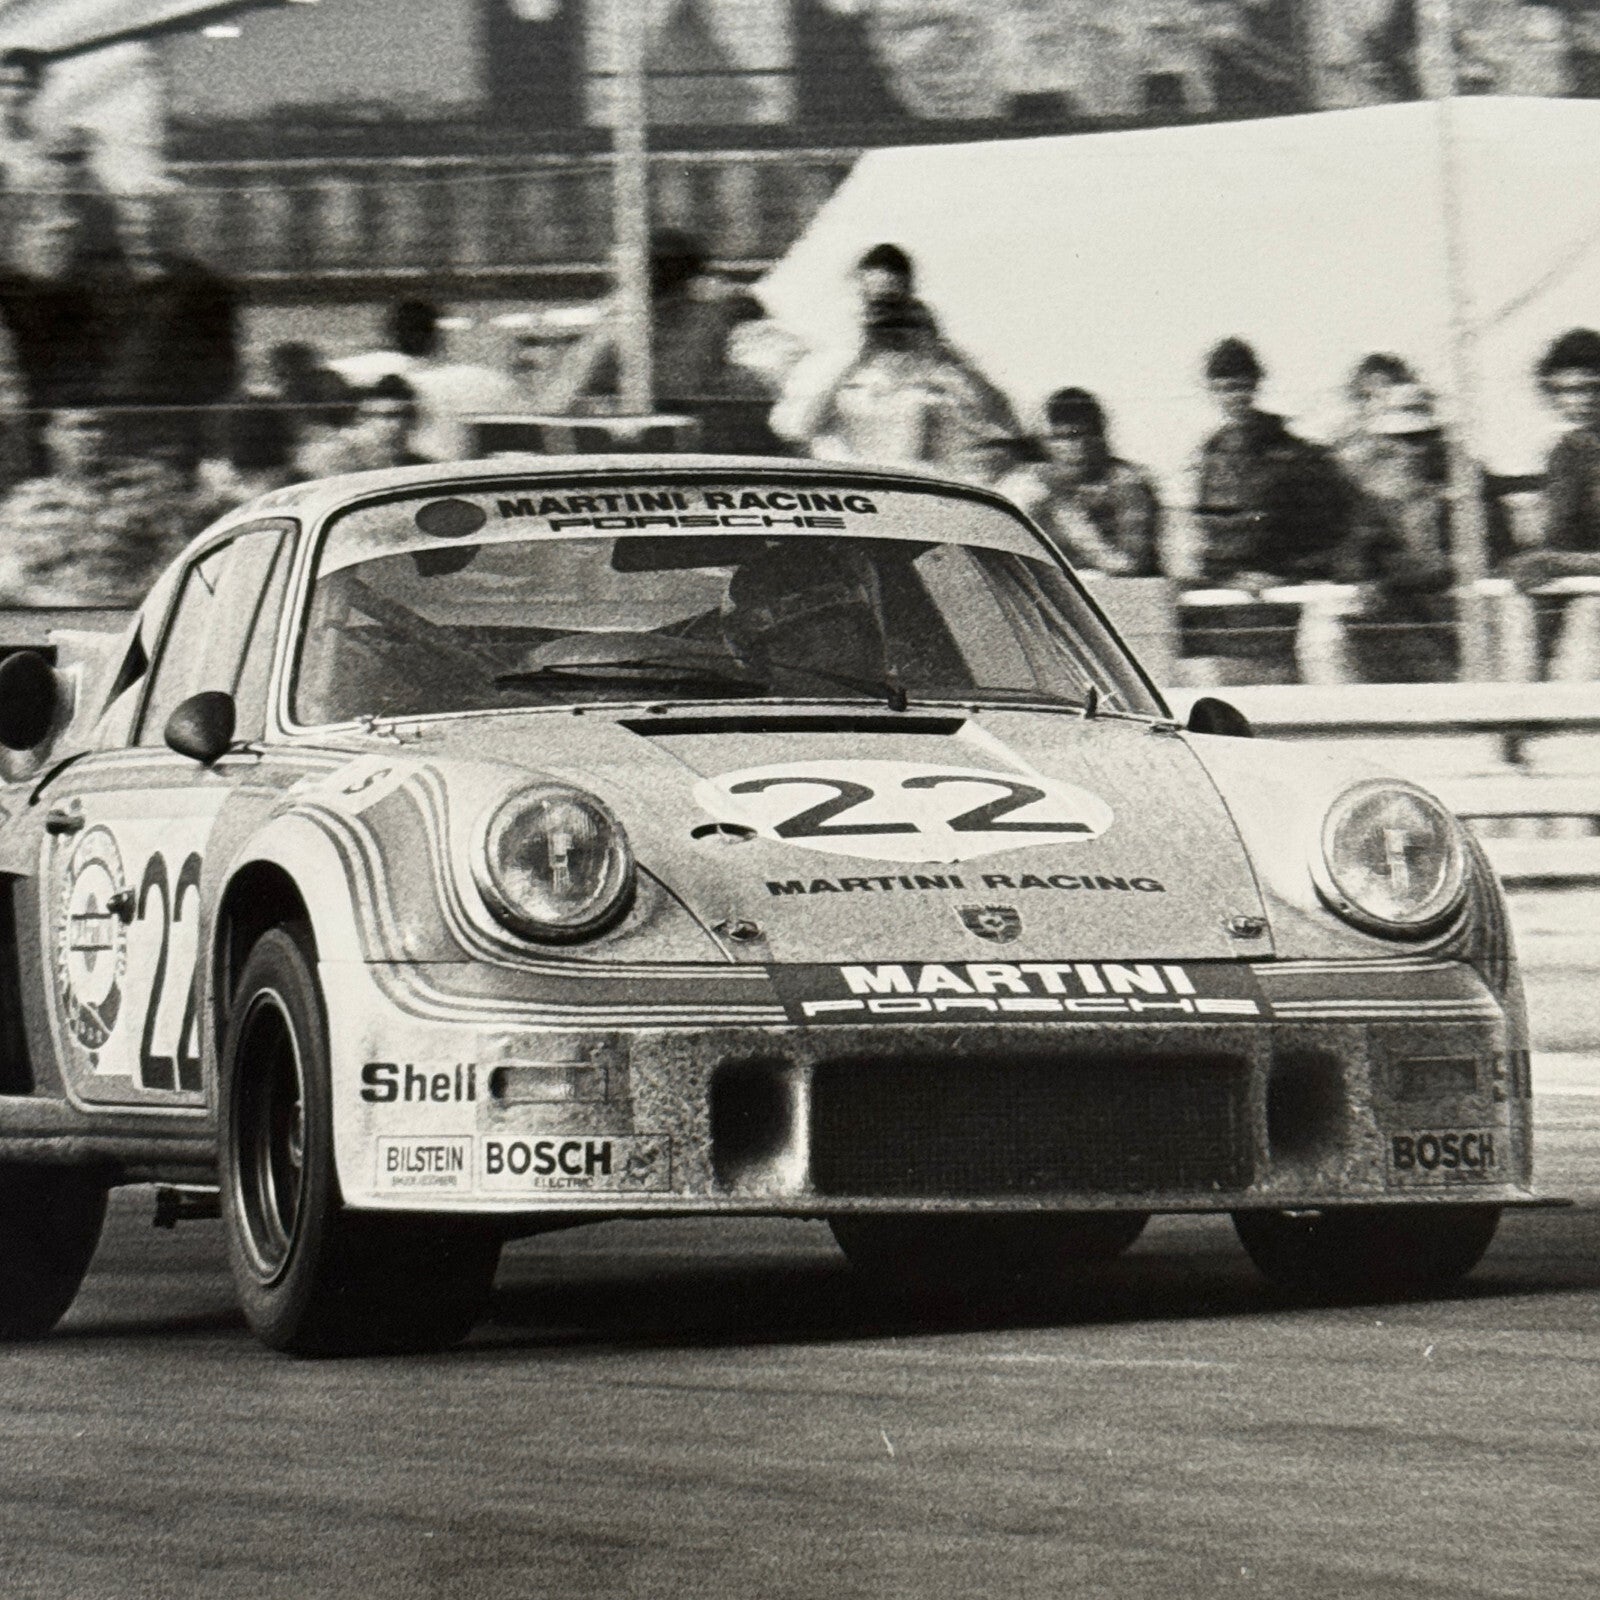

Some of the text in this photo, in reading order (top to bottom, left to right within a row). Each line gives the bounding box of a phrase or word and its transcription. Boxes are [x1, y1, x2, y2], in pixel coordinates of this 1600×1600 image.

[497, 491, 878, 518] MARTINI RACING
[550, 515, 846, 532] PORSCHE
[730, 775, 1095, 839] 22
[765, 873, 1166, 897] MARTINI RACING
[839, 963, 1197, 995] MARTINI
[801, 997, 1261, 1017] PORSCHE
[361, 1062, 477, 1103] Shell
[386, 1146, 463, 1172] BILSTEIN
[486, 1141, 612, 1175] BOSCH
[1391, 1133, 1495, 1170] BOSCH
